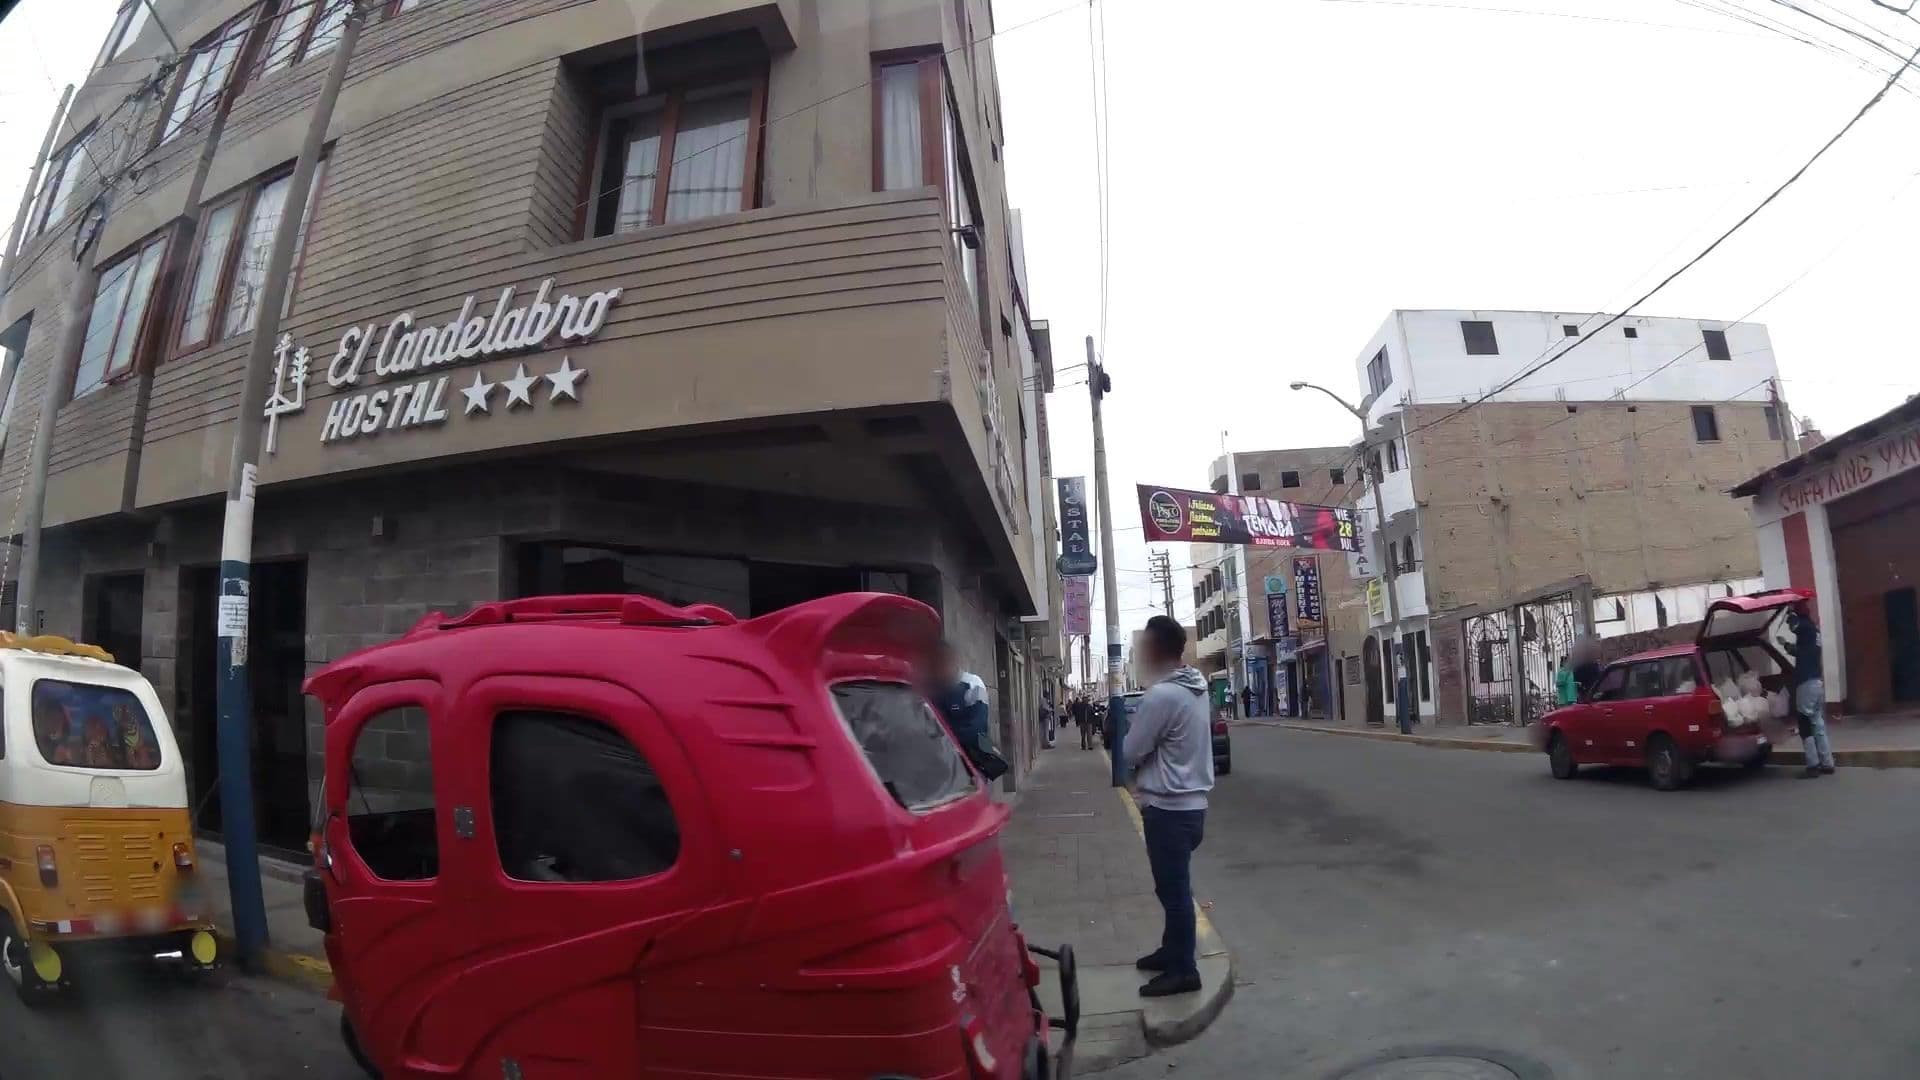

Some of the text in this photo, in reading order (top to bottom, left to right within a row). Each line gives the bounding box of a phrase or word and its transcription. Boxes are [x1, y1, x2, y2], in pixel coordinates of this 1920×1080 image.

[328, 276, 624, 388] El Candelabro
[319, 376, 450, 447] HOSTAL
[1062, 483, 1084, 553] HOSTAL
[1334, 508, 1349, 520] VIE
[1338, 520, 1352, 537] 28
[1341, 537, 1355, 551] JUL
[1295, 569, 1307, 618] IMPRENTA
[1308, 569, 1320, 621] INTERNET
